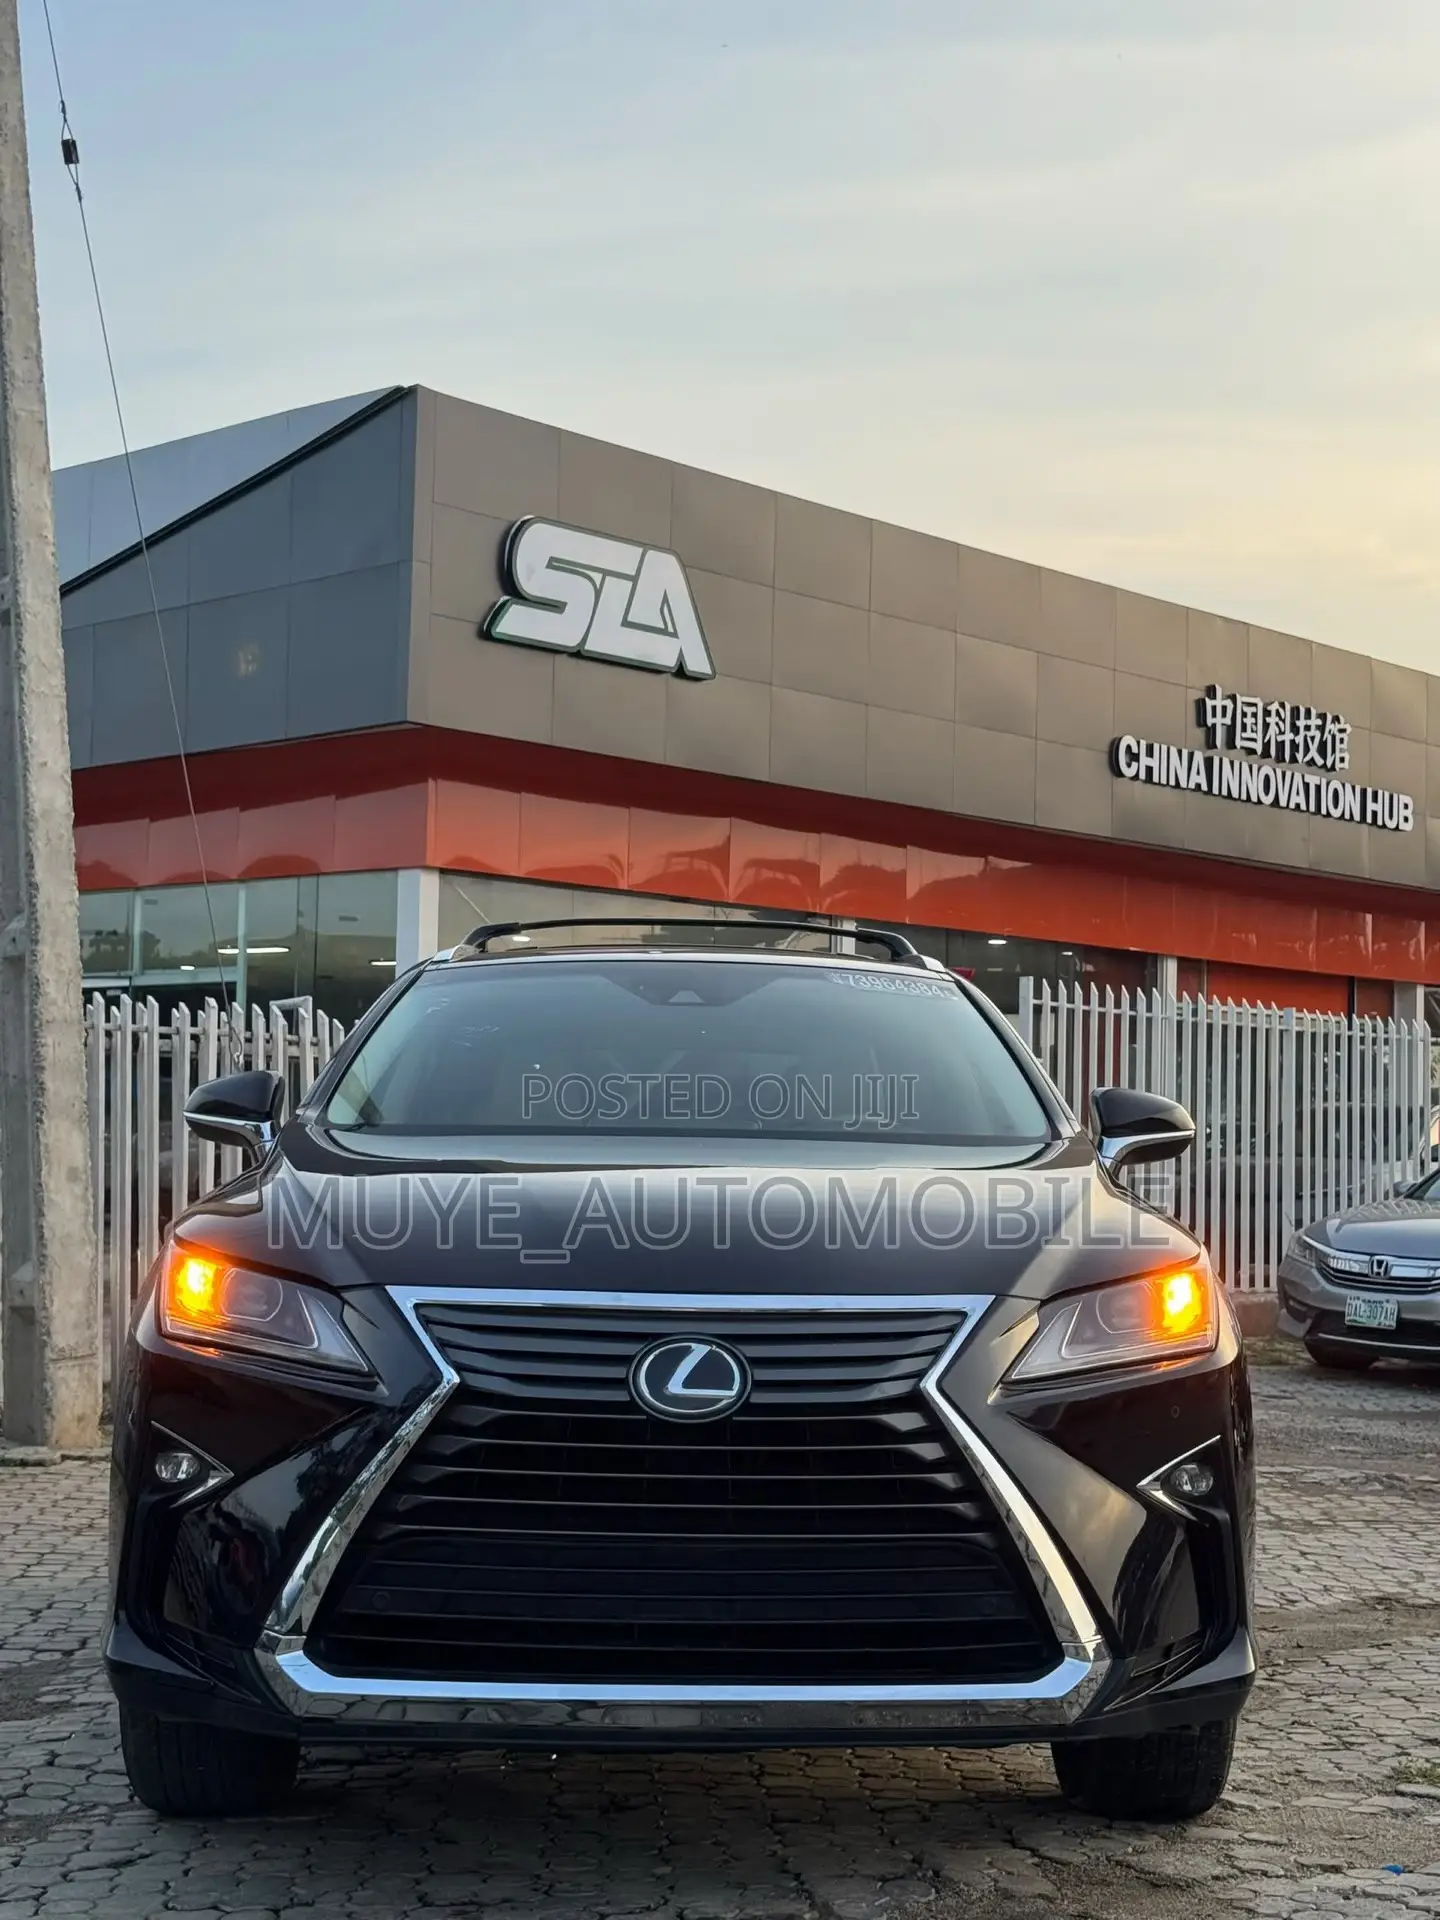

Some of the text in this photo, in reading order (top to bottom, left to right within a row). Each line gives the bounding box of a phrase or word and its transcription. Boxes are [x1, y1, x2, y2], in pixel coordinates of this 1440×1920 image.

[1202, 684, 1351, 773] 中国科技馆
[1115, 735, 1414, 832] CHINA INNOVATION HUB
